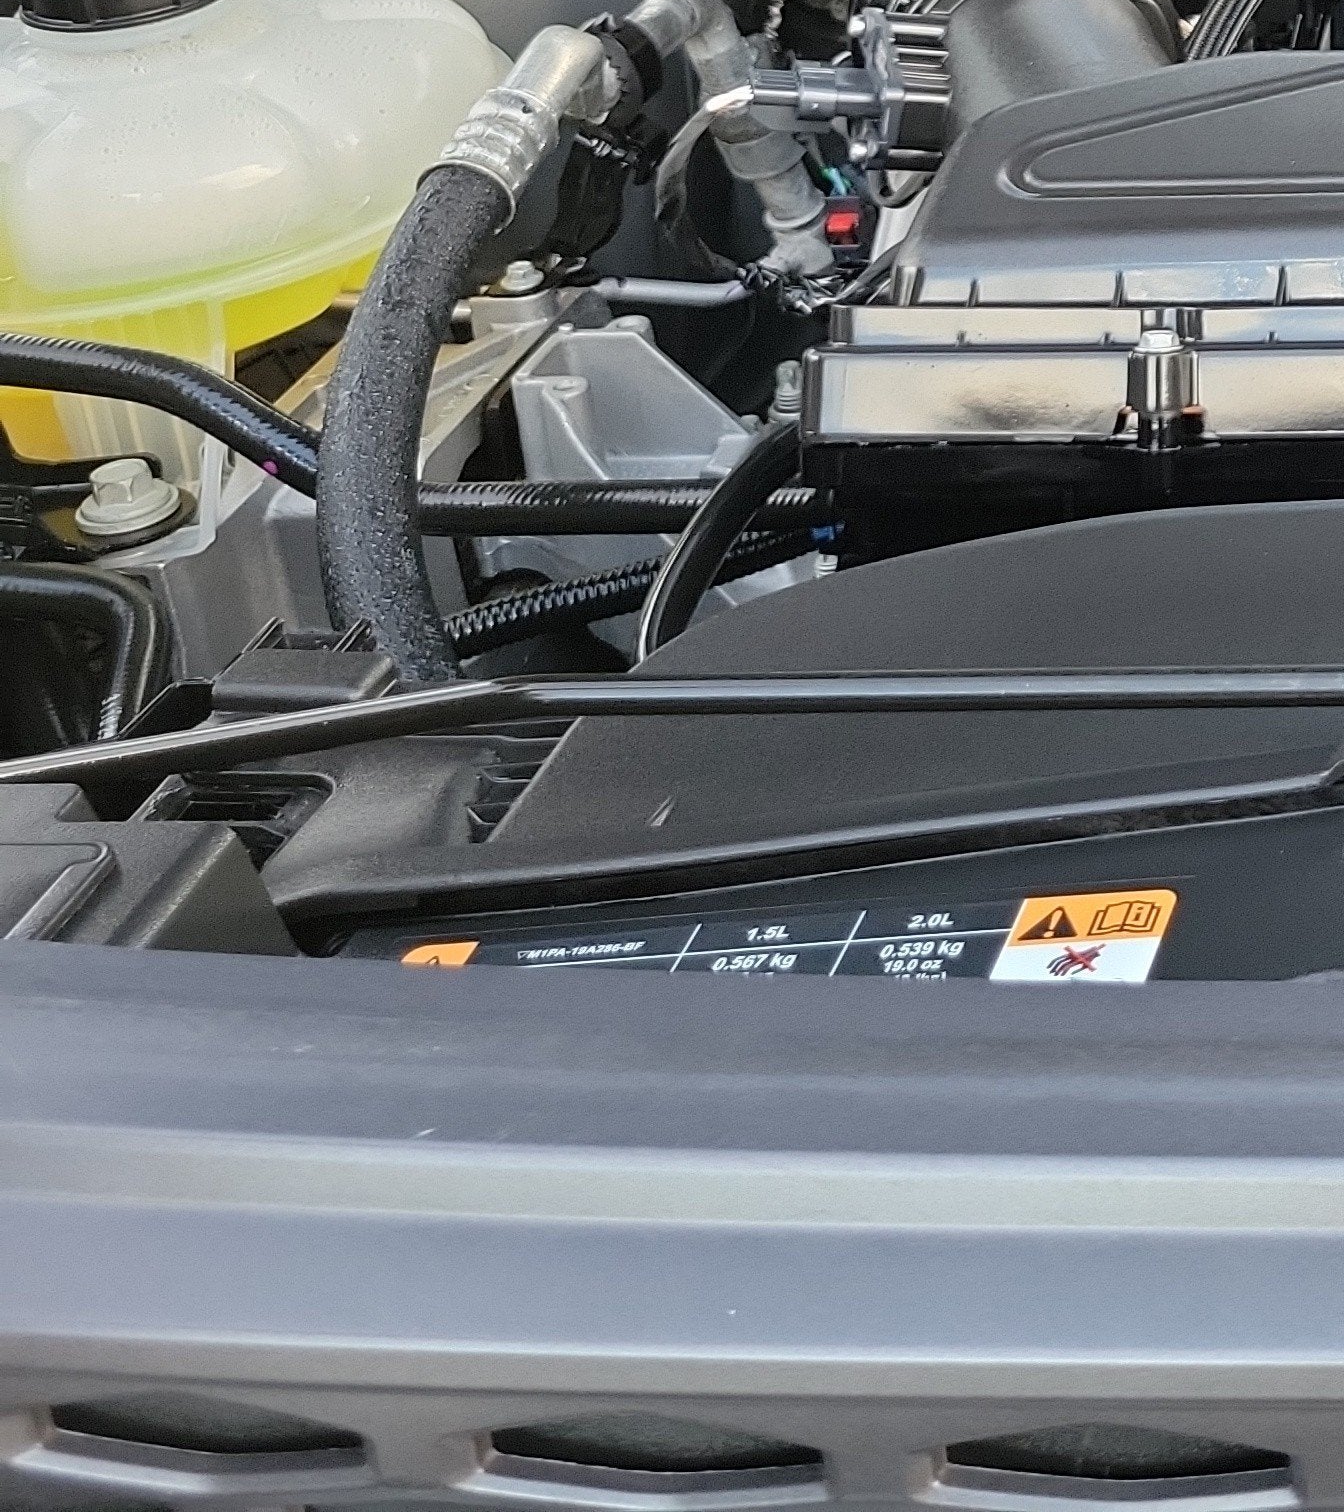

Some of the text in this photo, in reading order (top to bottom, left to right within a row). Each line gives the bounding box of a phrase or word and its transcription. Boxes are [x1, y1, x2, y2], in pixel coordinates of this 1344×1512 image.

[906, 912, 954, 929] 2.0L
[747, 925, 790, 941] 1.5L
[878, 939, 965, 959] 0.539 kg
[711, 953, 798, 971] 0.567 kg
[883, 958, 944, 973] 19.0 oz
